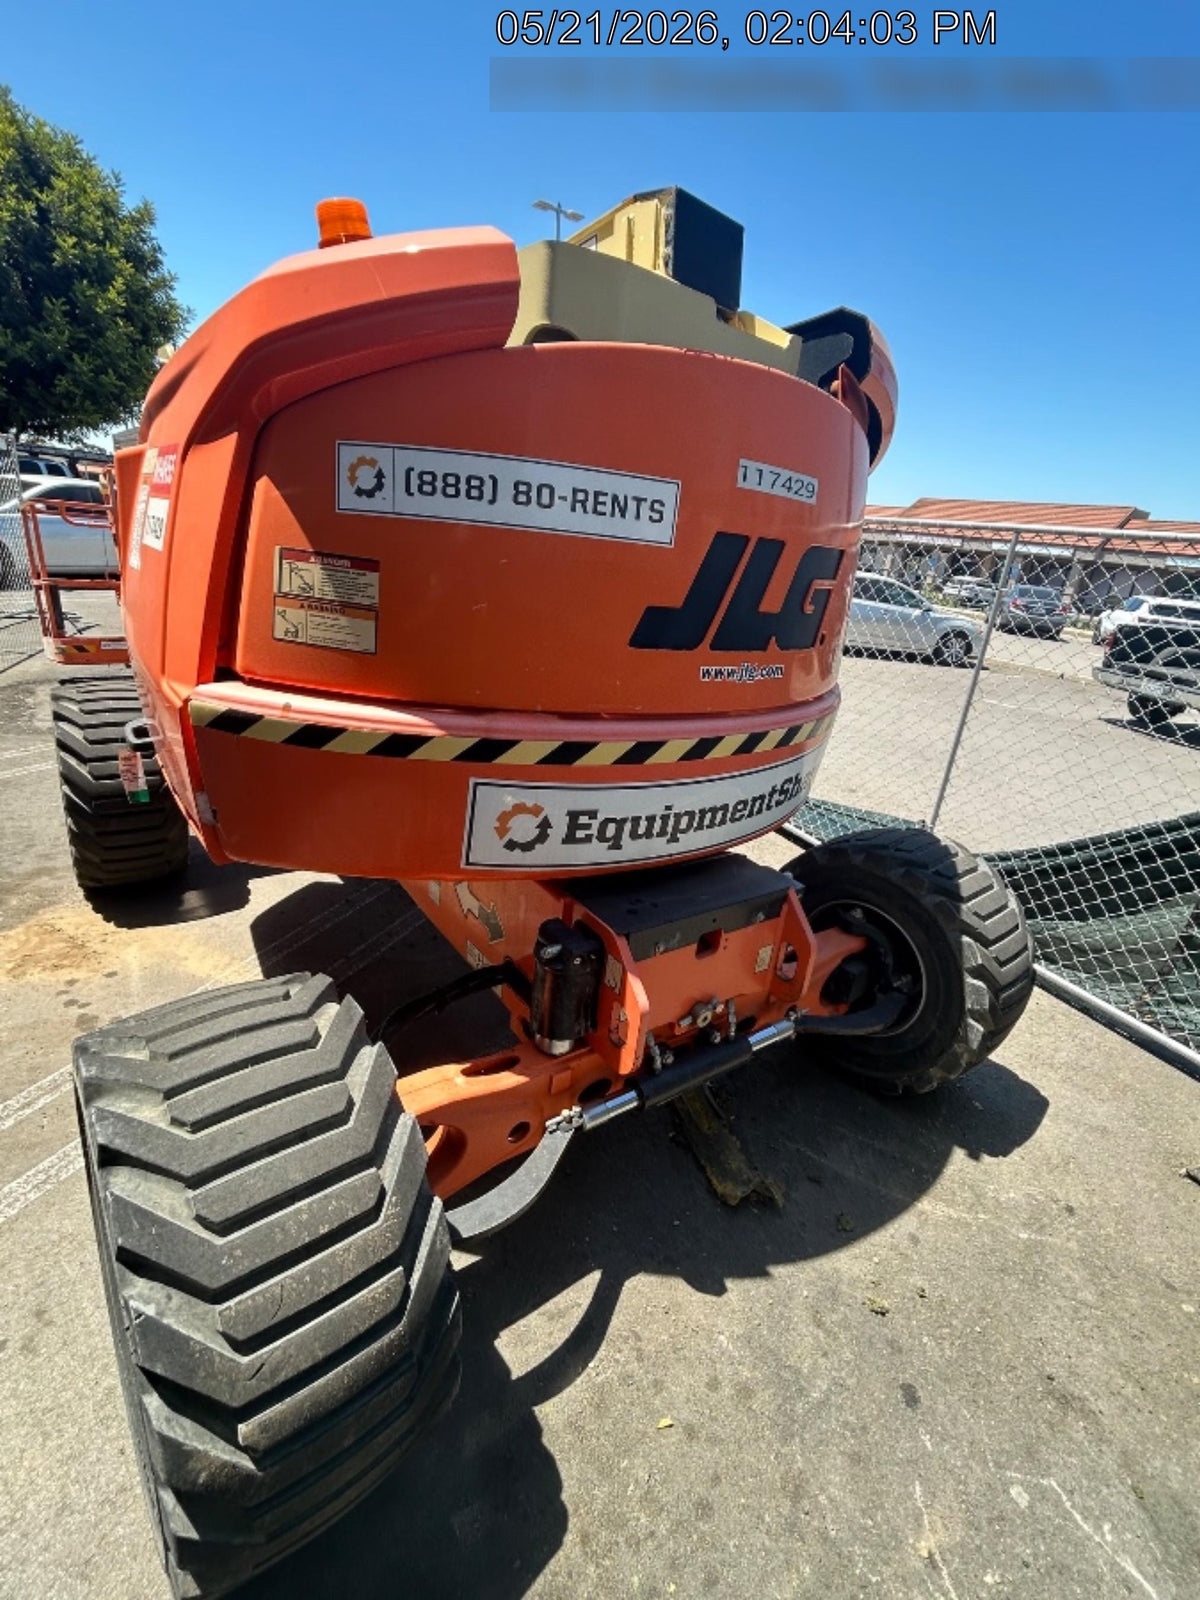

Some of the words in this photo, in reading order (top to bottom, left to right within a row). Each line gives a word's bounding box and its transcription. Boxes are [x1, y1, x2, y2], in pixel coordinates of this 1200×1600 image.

[404, 467, 498, 505] (888)
[512, 480, 666, 524] 80-RENTS
[739, 464, 816, 499] 117429
[628, 531, 845, 652] JLG
[700, 664, 784, 682] www.jlg.com
